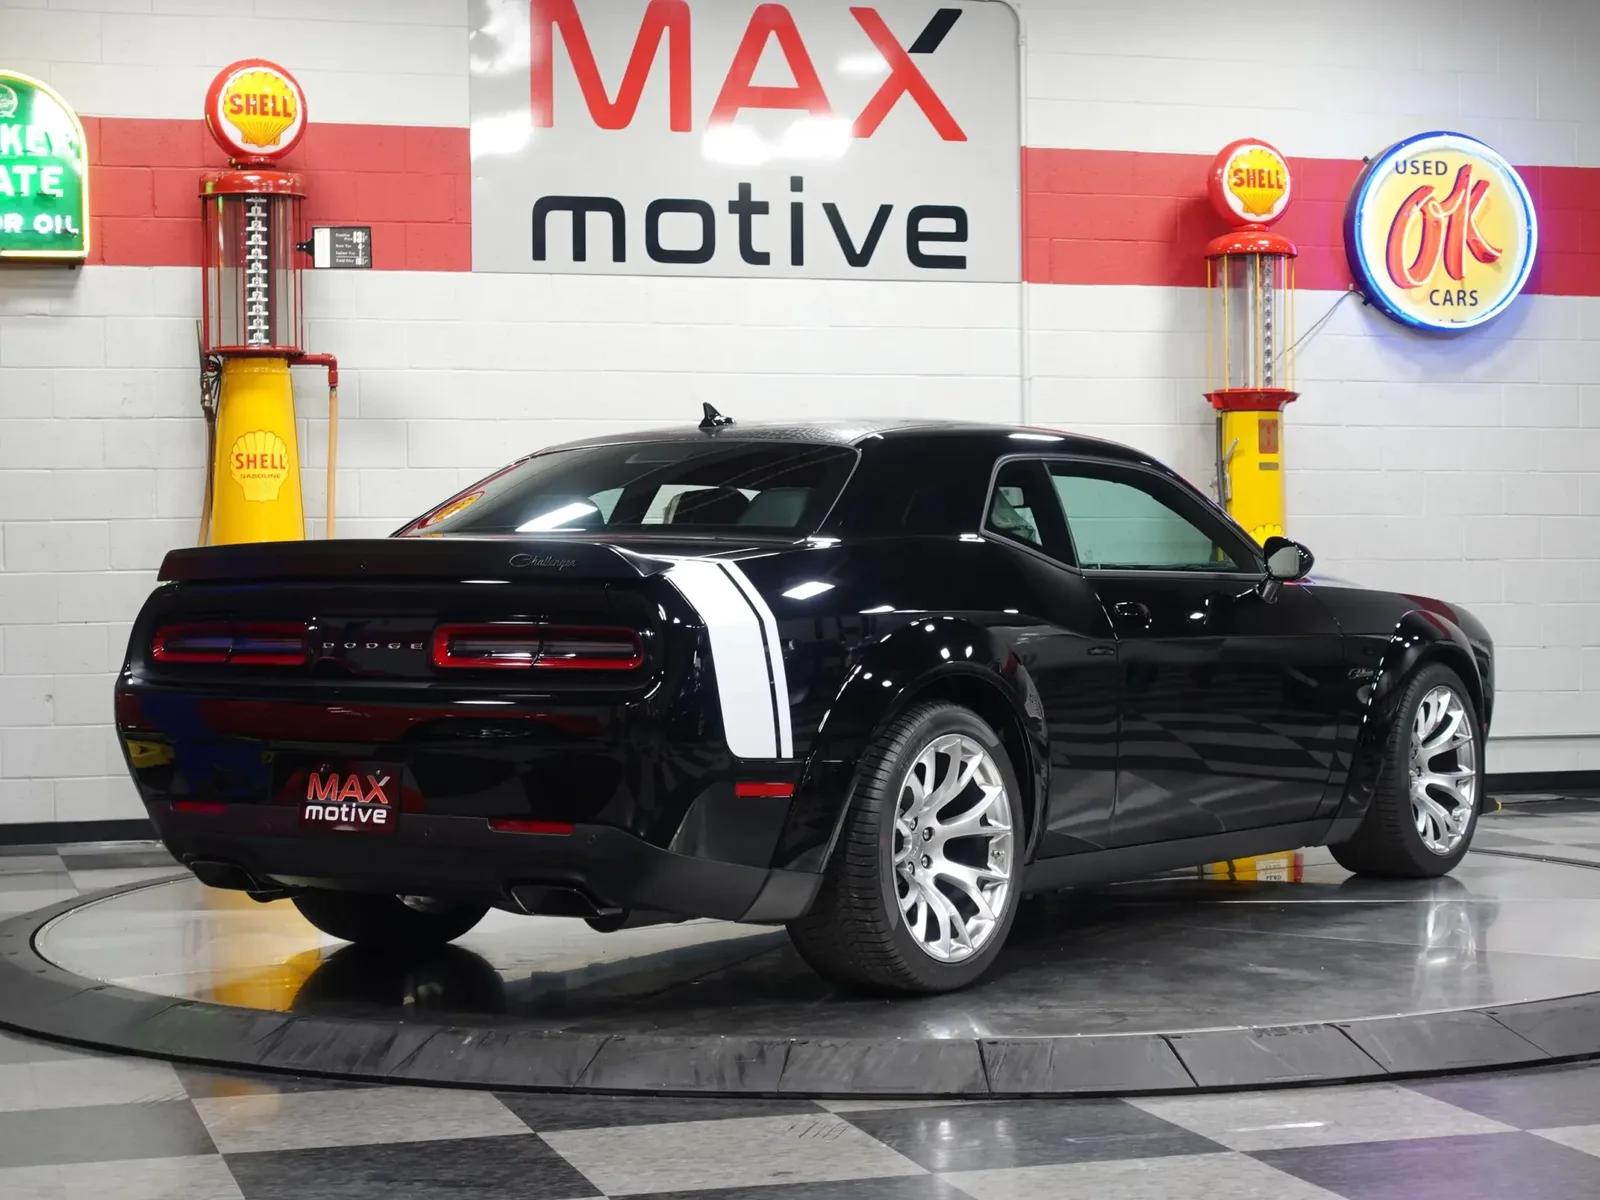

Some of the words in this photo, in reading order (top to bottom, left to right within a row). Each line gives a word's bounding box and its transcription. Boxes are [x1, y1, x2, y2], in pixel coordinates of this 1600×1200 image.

[529, 0, 968, 141] MAX
[229, 93, 292, 118] SHELL
[1233, 168, 1283, 189] SHELL
[1395, 160, 1448, 176] USED
[33, 214, 79, 235] OIL
[532, 176, 968, 269] motive
[1385, 164, 1502, 289] OK
[1429, 289, 1479, 307] CARS
[235, 453, 286, 470] SHELL
[509, 553, 577, 571] Challenger
[323, 642, 423, 650] DODGE
[307, 772, 391, 804] MAX
[305, 802, 387, 824] motive
